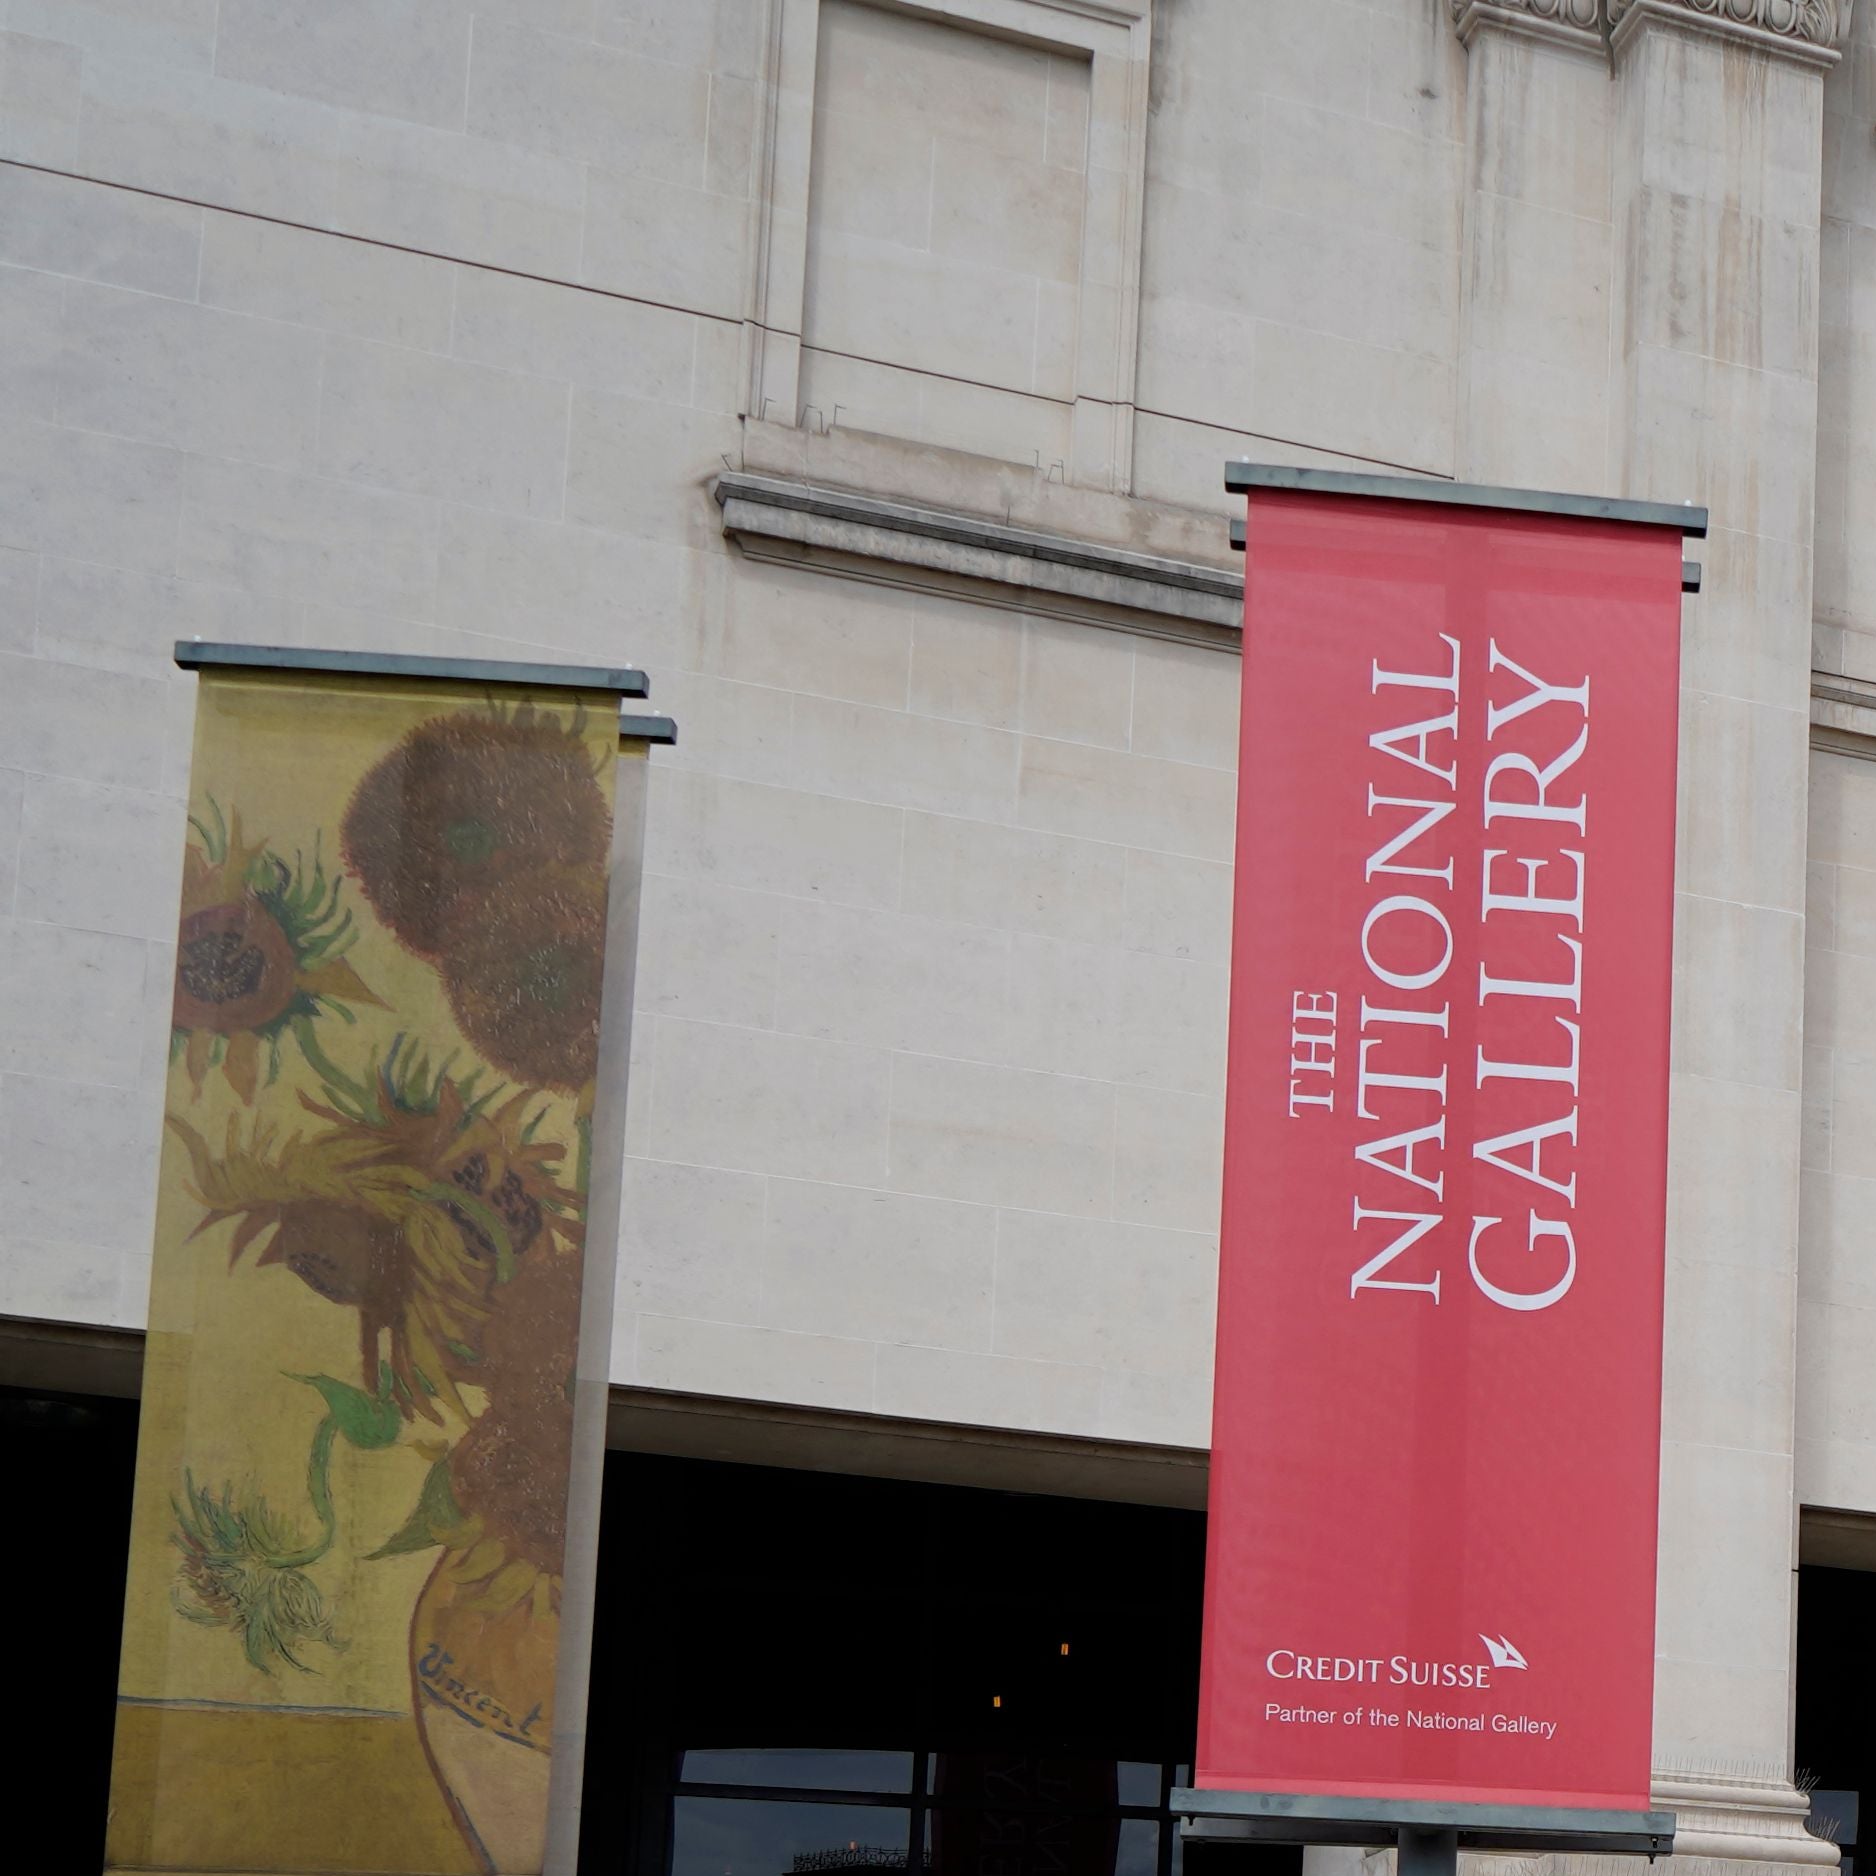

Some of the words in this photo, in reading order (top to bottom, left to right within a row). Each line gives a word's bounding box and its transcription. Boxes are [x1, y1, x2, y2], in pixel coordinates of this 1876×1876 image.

[1350, 632, 1461, 1306] NATIONAL
[1468, 637, 1590, 1312] GALLERY
[1289, 990, 1338, 1119] THE
[1265, 1703, 1336, 1724] Partner
[1343, 1707, 1363, 1725] of
[1369, 1708, 1400, 1727] the
[1407, 1710, 1484, 1731] National
[1491, 1714, 1557, 1739] Gallery
[1266, 1649, 1384, 1683] CREDIT
[1389, 1656, 1491, 1688] SUISSE
